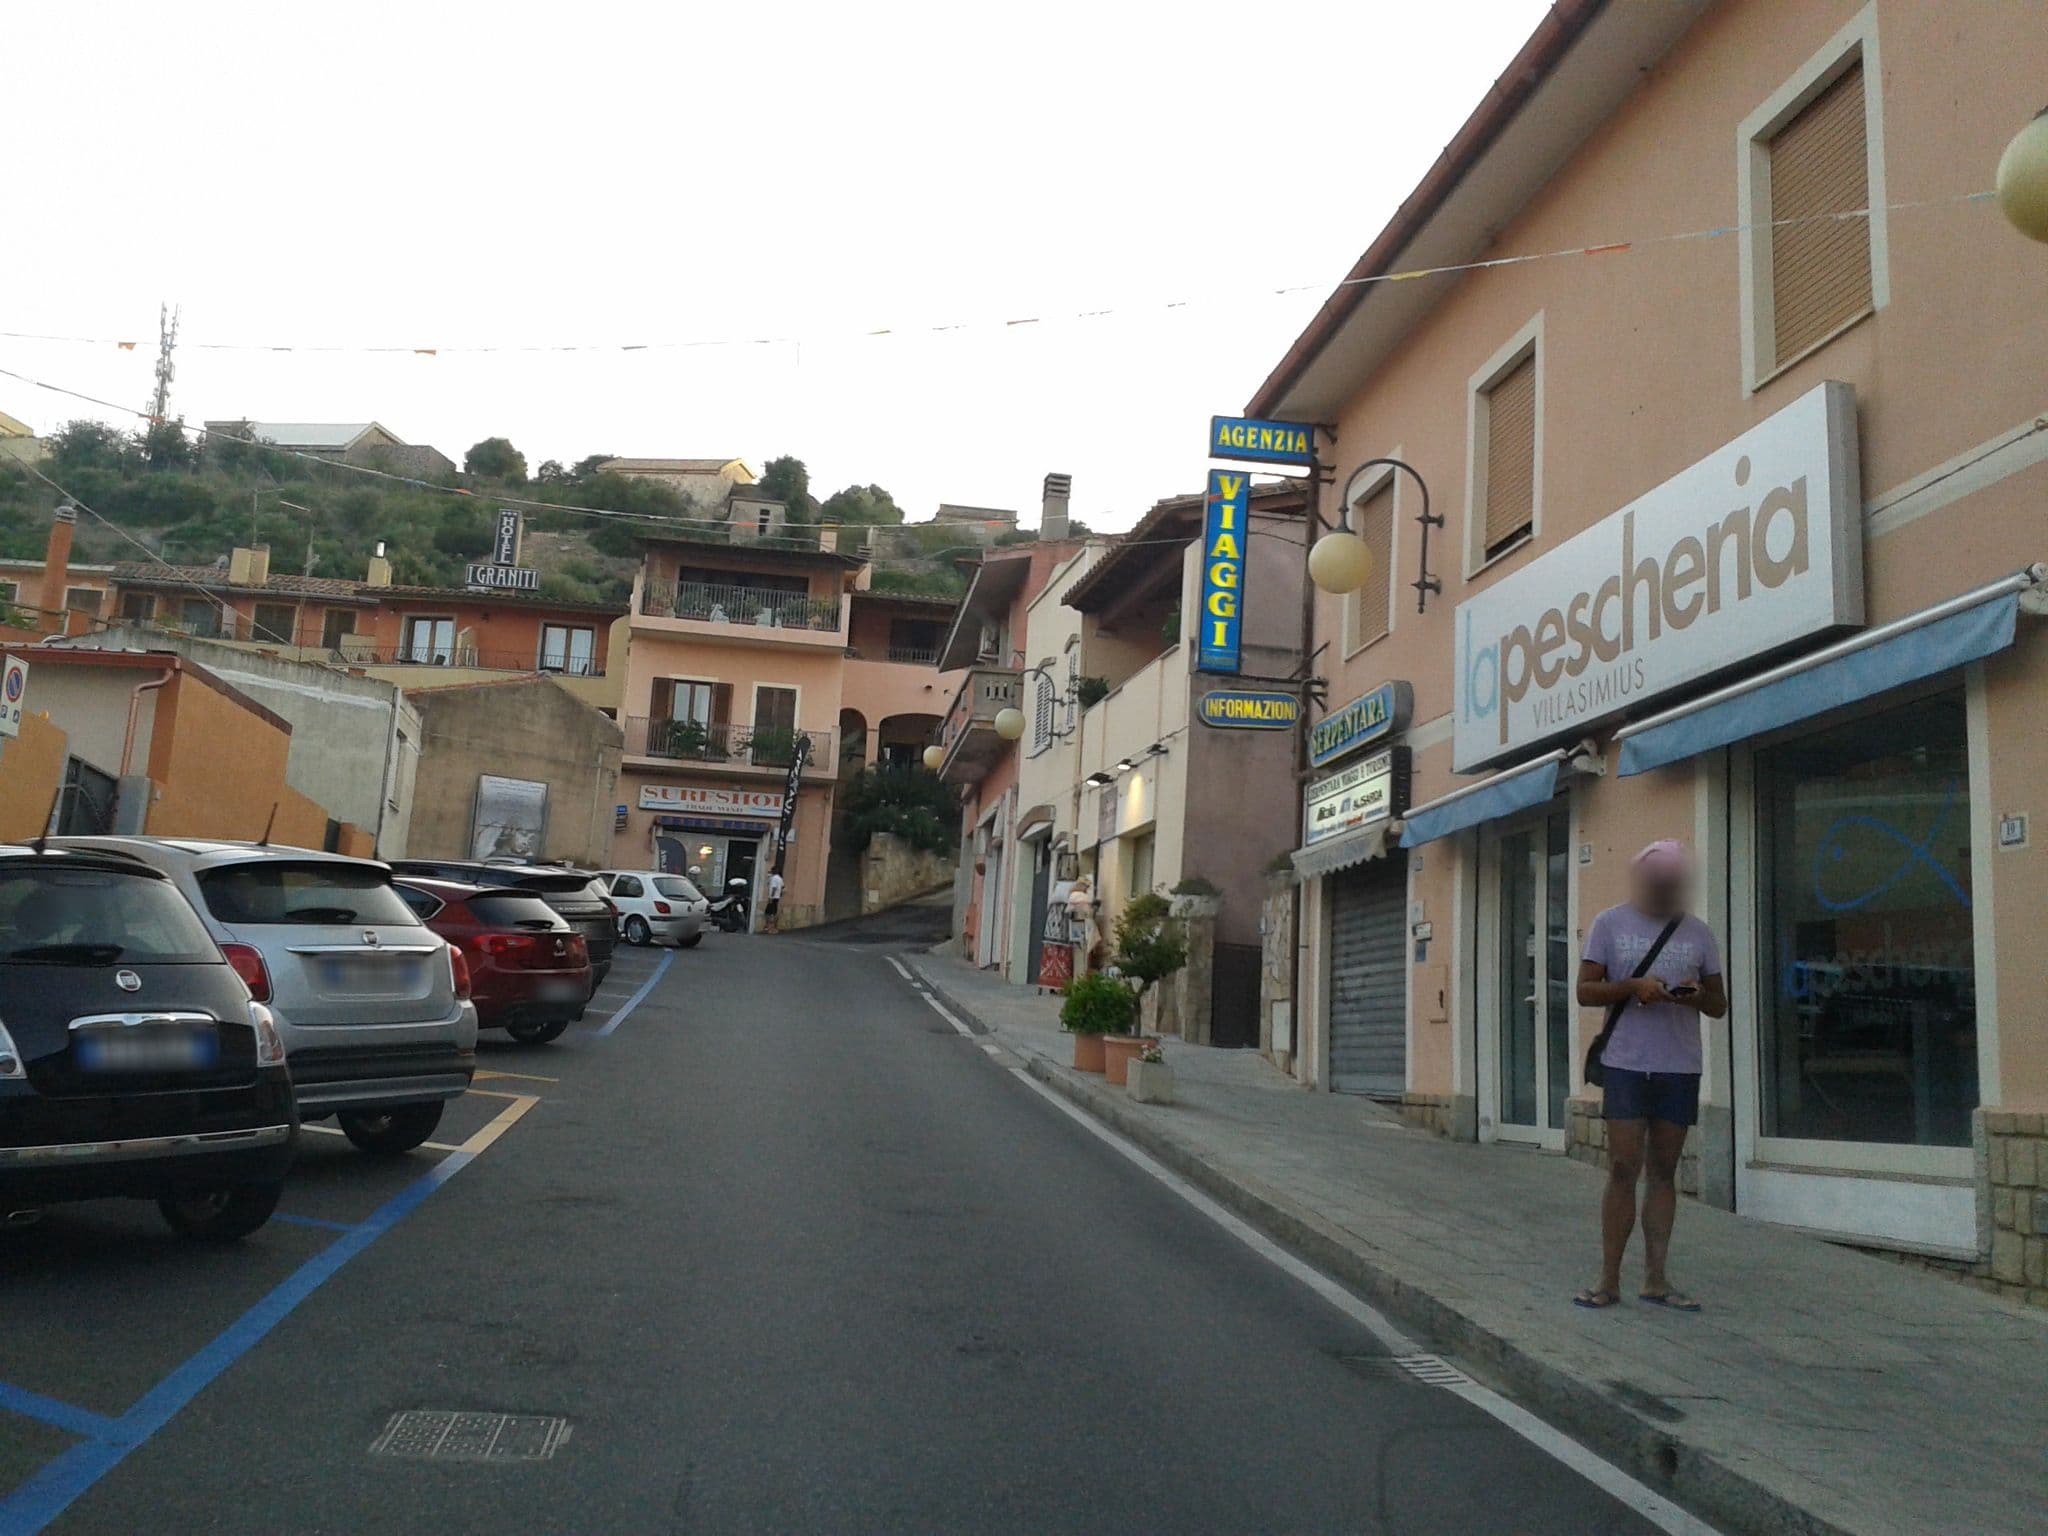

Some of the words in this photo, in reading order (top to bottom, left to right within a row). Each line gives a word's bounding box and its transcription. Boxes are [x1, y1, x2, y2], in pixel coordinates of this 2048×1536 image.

[1217, 424, 1308, 454] AGENZIA
[501, 516, 515, 563] HOTEL
[1207, 475, 1244, 647] VIAGGI
[468, 566, 474, 583] I
[477, 567, 537, 588] GRANITI
[1205, 698, 1297, 720] INFORMAZIONI
[1532, 659, 1646, 729] VILLASIMIUS
[1311, 693, 1387, 756] SERPENTARA
